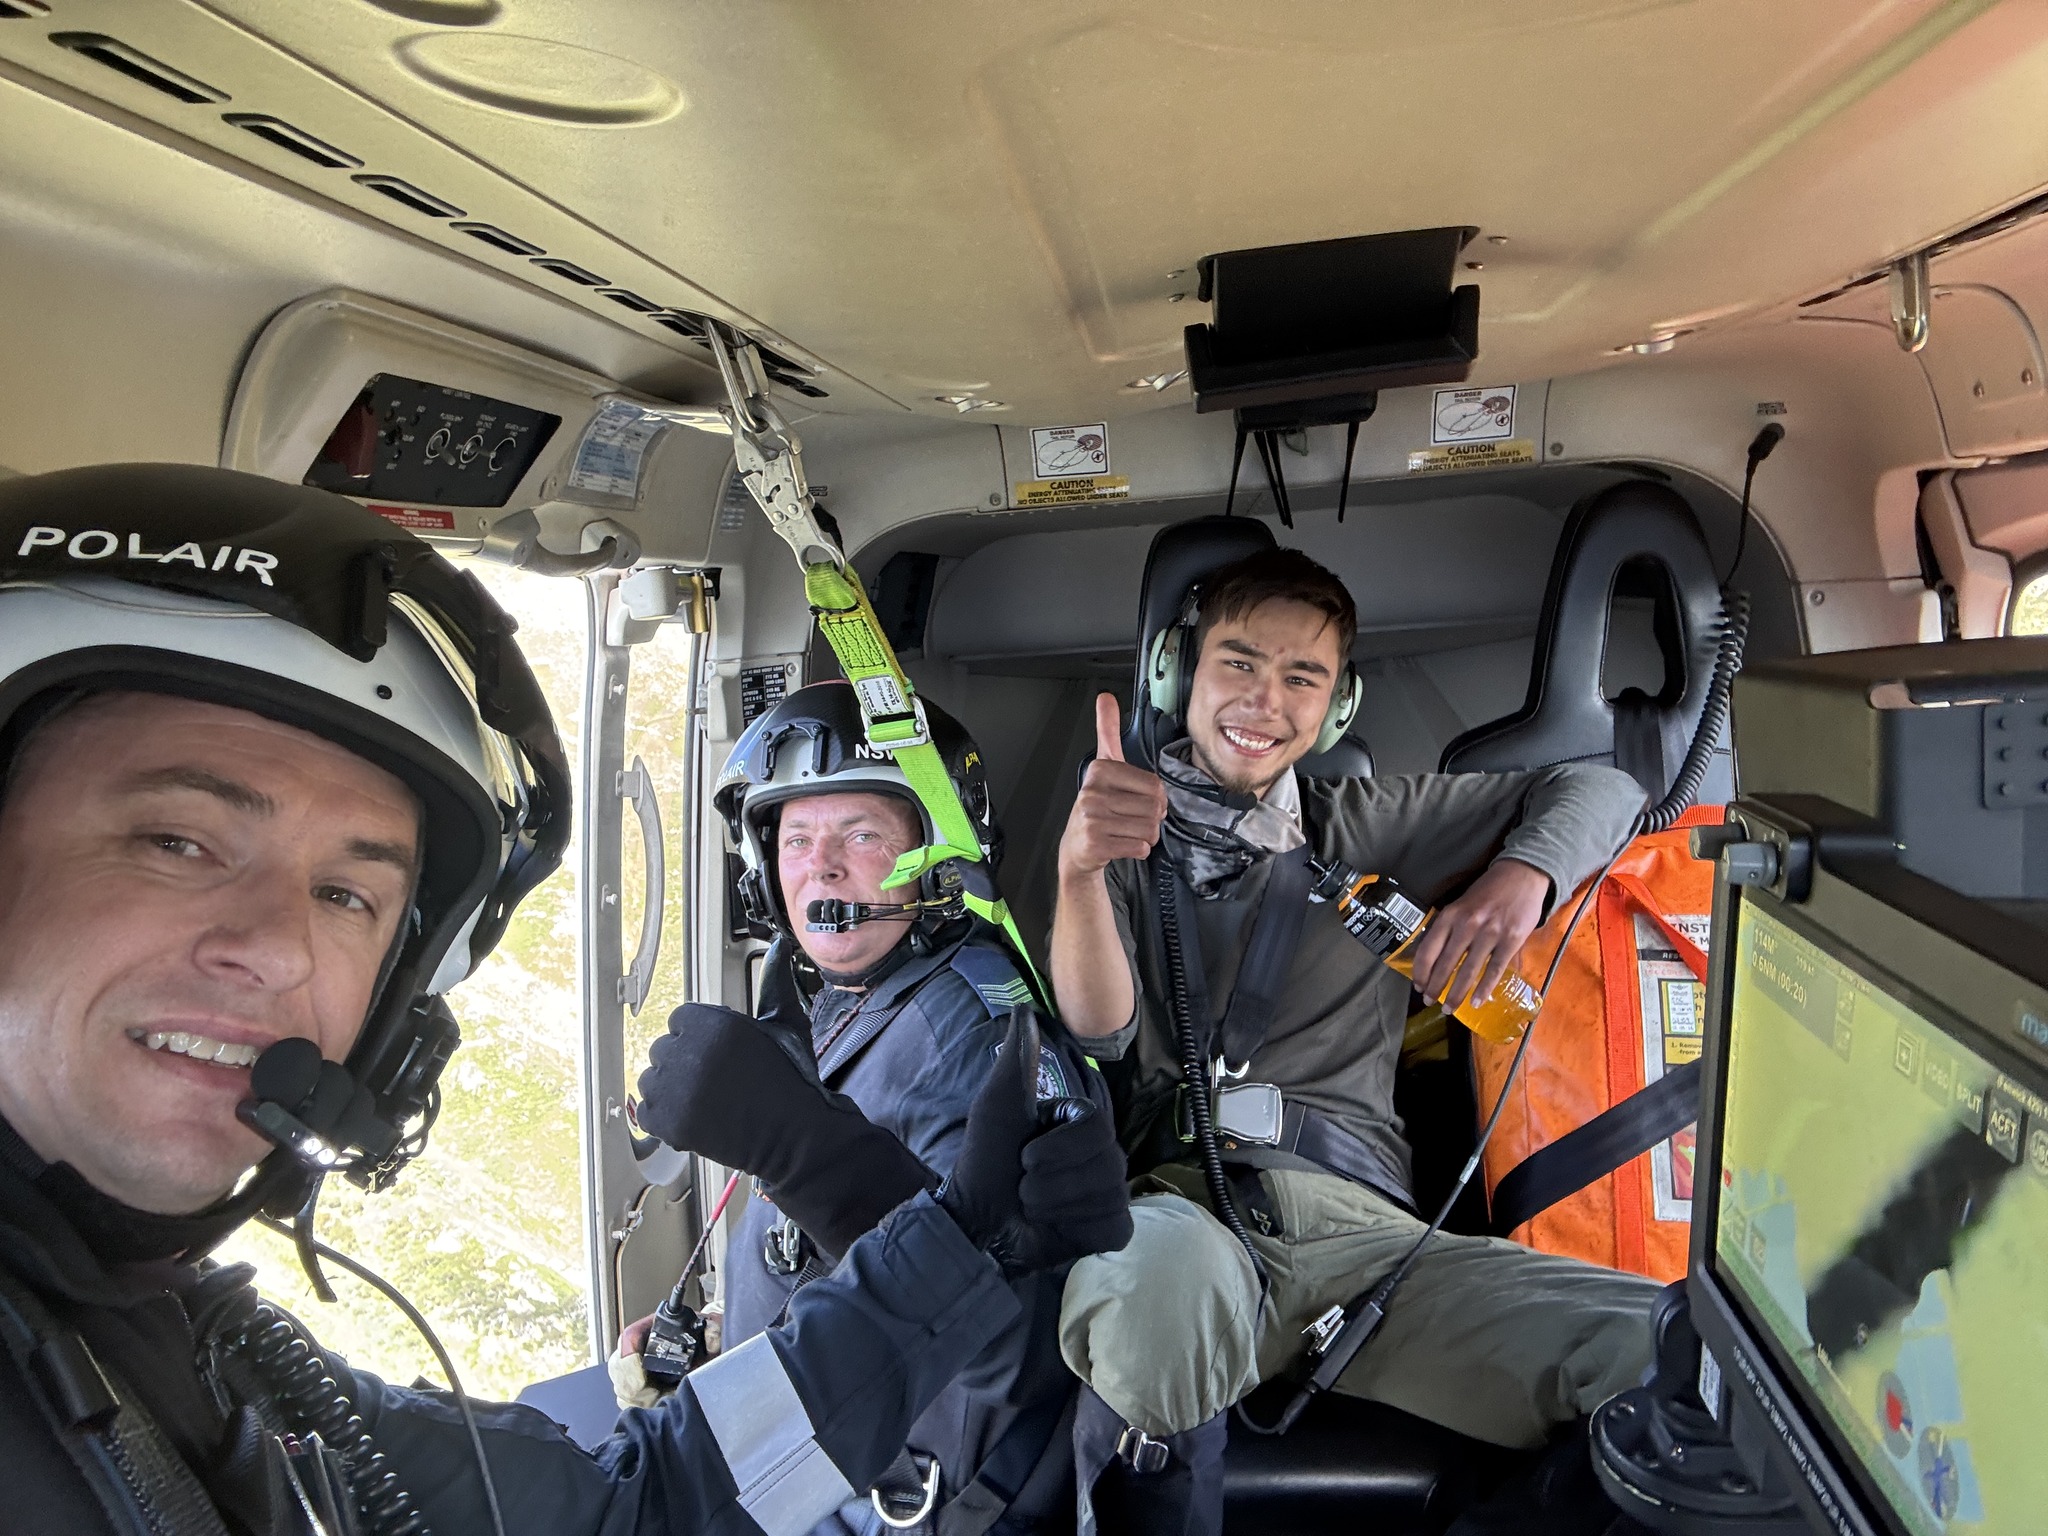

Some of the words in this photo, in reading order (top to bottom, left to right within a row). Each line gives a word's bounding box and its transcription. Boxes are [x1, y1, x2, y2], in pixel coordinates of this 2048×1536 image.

[1447, 443, 1496, 456] CAUTION
[1452, 452, 1498, 461] ATTENUATING
[1499, 449, 1521, 457] SEATS
[1422, 463, 1452, 472] OBJECTS
[1452, 460, 1487, 469] ALLOWED
[1487, 458, 1511, 466] UNDER
[1511, 455, 1533, 464] SEATS
[1050, 479, 1094, 490] CAUTION
[1028, 490, 1052, 498] ENERGY
[1053, 487, 1096, 497] ATTENUATING
[1028, 497, 1055, 505] OBJECTS
[1055, 494, 1086, 502] ALLOWED
[1086, 492, 1107, 500] UNDER
[1108, 491, 1128, 499] SEATS
[17, 526, 279, 587] POLAIR
[1350, 923, 1366, 935] FIFA
[1956, 1082, 1982, 1114] SPLIT
[1991, 1109, 2018, 1140] ACFT
